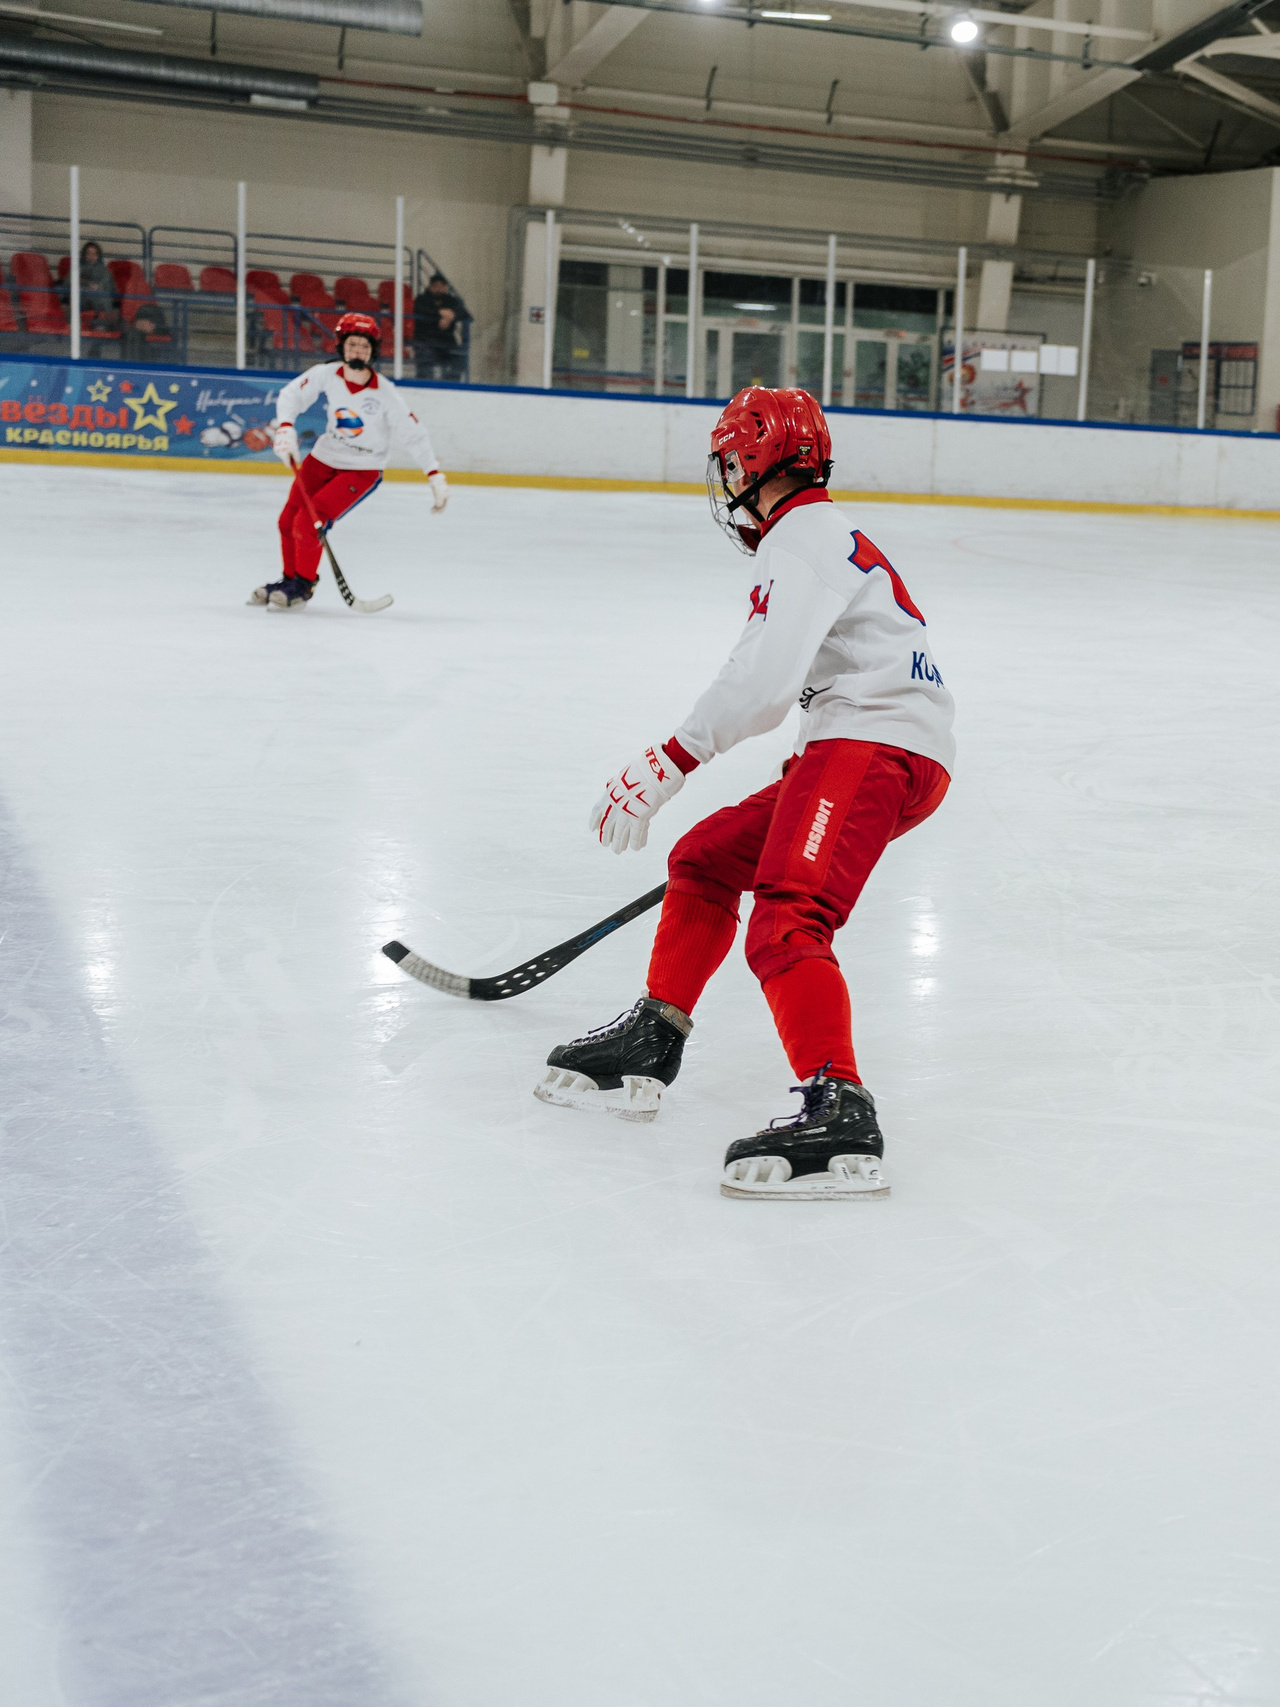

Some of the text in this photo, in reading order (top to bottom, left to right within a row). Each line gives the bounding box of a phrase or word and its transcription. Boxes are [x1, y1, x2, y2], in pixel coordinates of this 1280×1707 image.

[5, 427, 170, 451] КРАСНОЯРЬЯ
[718, 431, 735, 445] CCM
[645, 746, 671, 783] TEX
[802, 798, 834, 862] rusport
